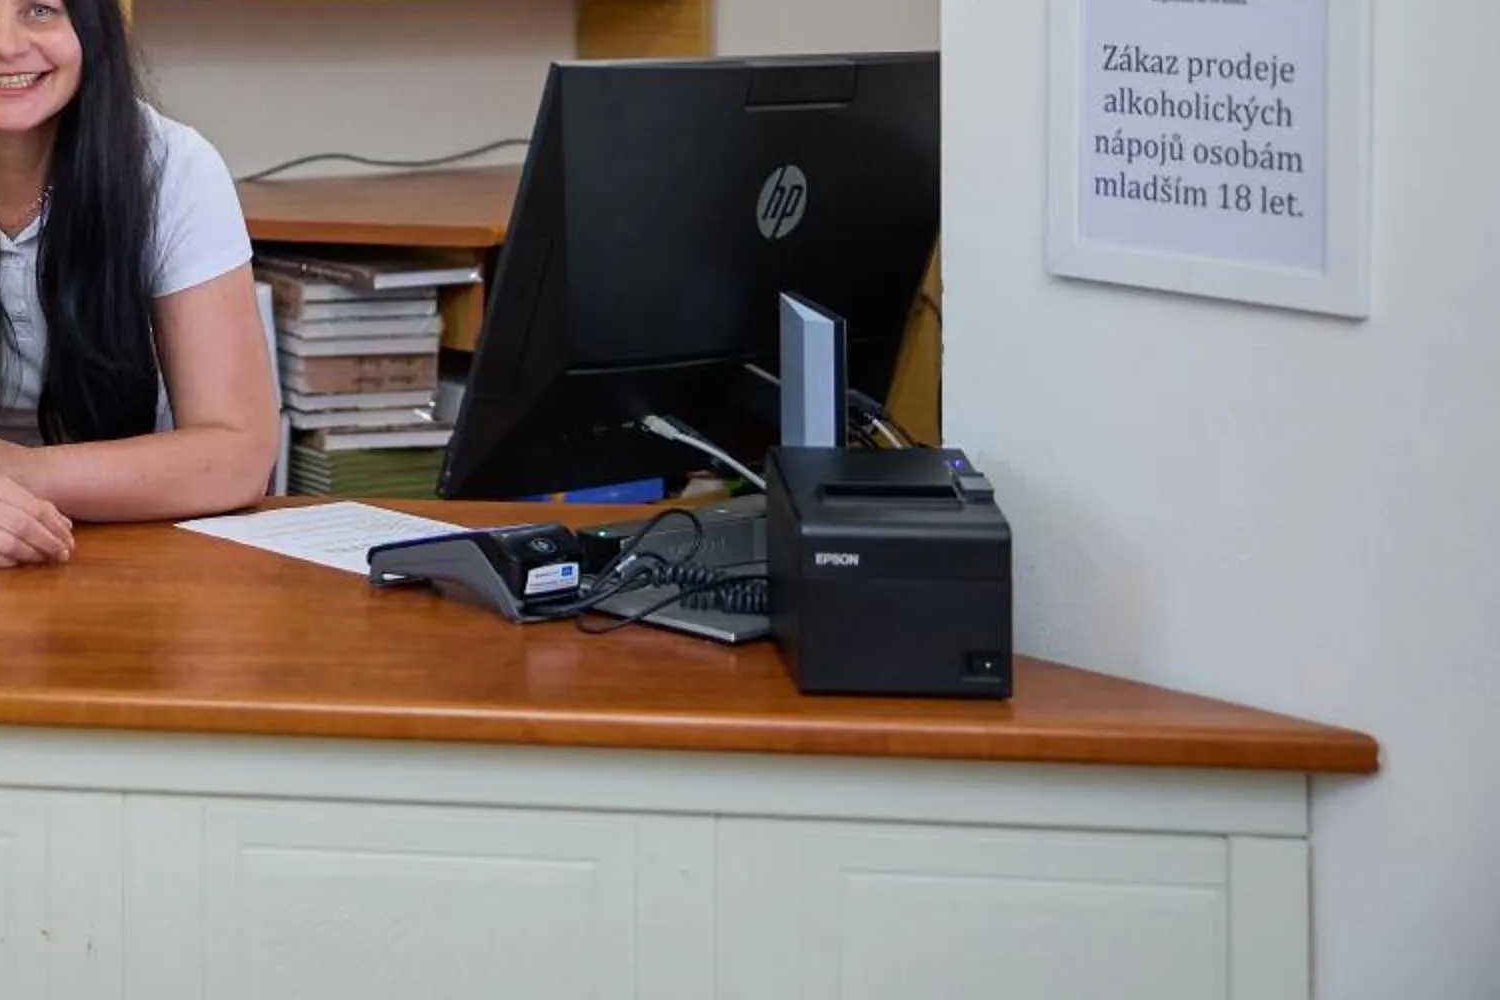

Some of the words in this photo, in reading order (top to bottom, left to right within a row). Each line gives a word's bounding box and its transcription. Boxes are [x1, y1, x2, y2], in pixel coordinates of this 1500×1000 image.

[1102, 44, 1180, 77] Zákaz
[1186, 51, 1296, 89] prodeje
[1103, 87, 1293, 131] alkoholických
[1094, 130, 1185, 166] nápojů
[1193, 138, 1304, 174] osobám
[1094, 173, 1208, 208] mladším
[1218, 183, 1252, 212] 18
[1260, 187, 1304, 218] let.
[814, 552, 859, 567] EPSON
